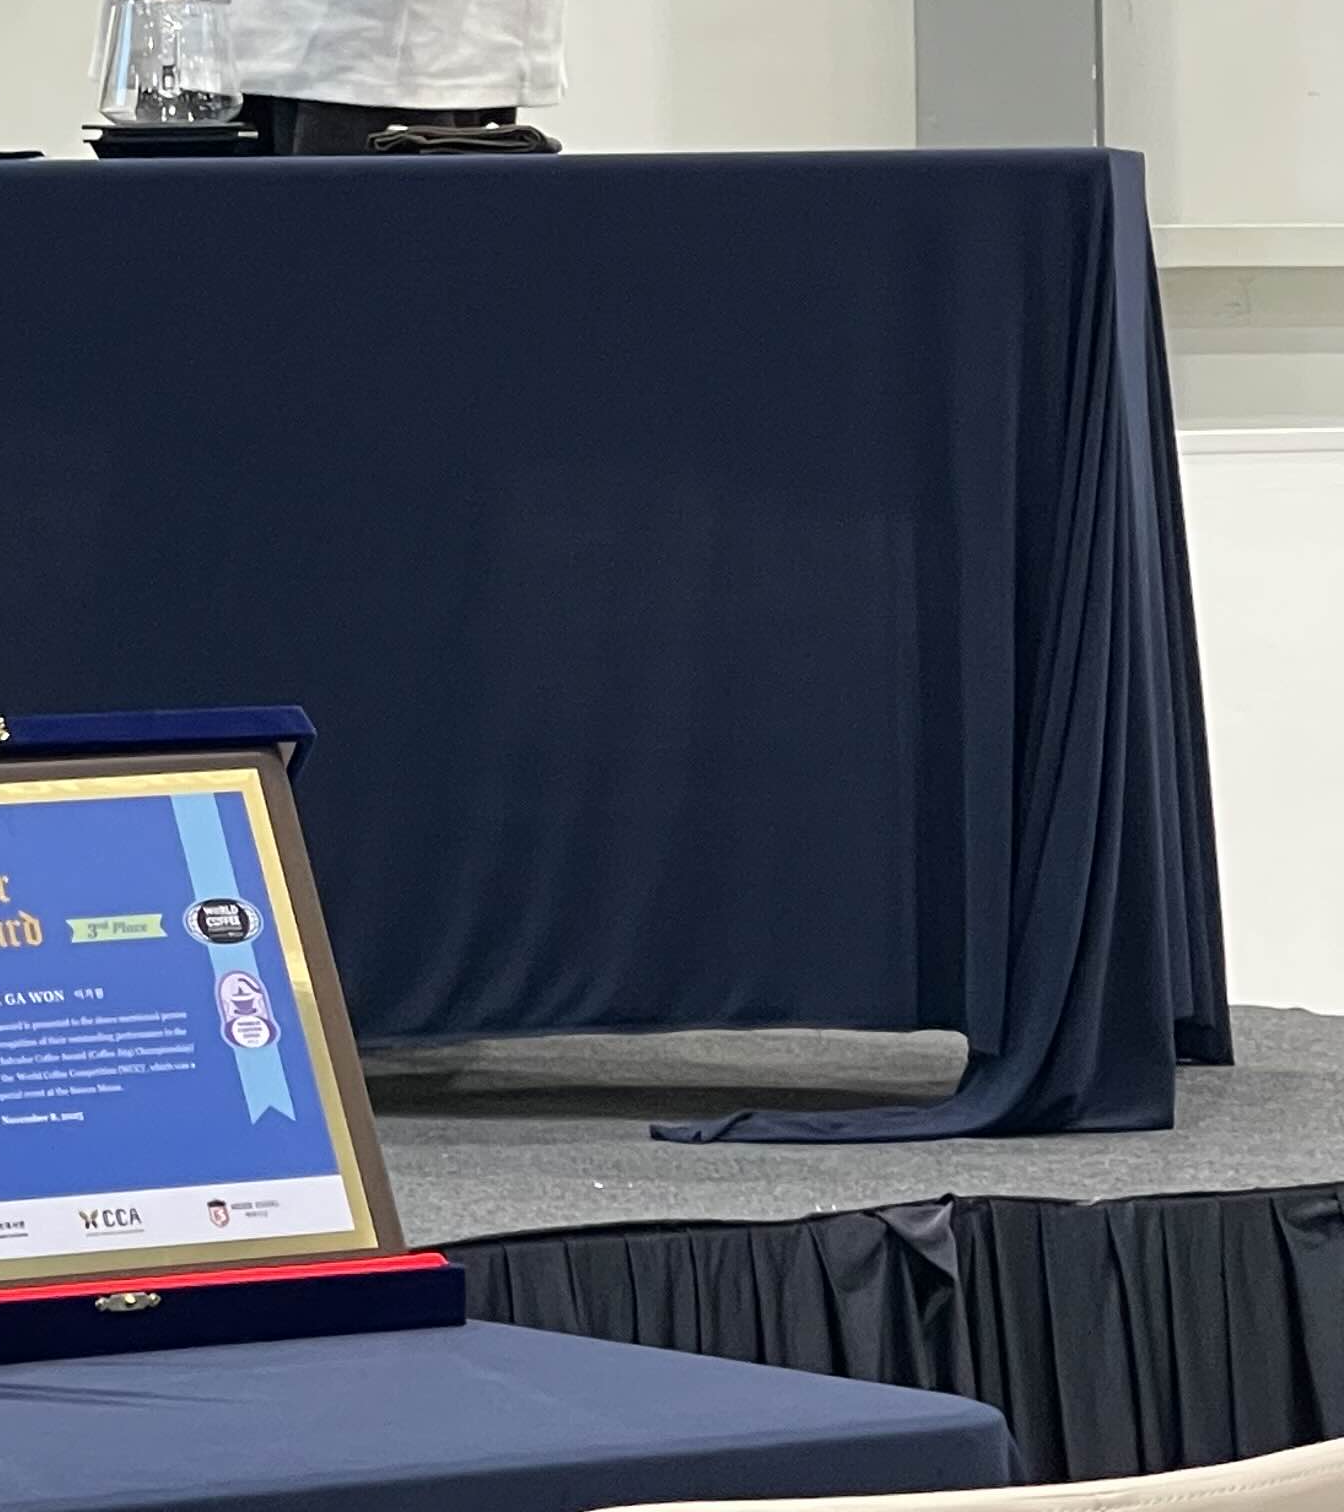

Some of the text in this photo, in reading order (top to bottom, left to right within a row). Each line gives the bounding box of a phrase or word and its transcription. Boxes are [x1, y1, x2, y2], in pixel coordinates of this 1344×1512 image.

[112, 920, 148, 934] Place
[4, 992, 26, 1005] GA
[28, 989, 65, 1003] WON
